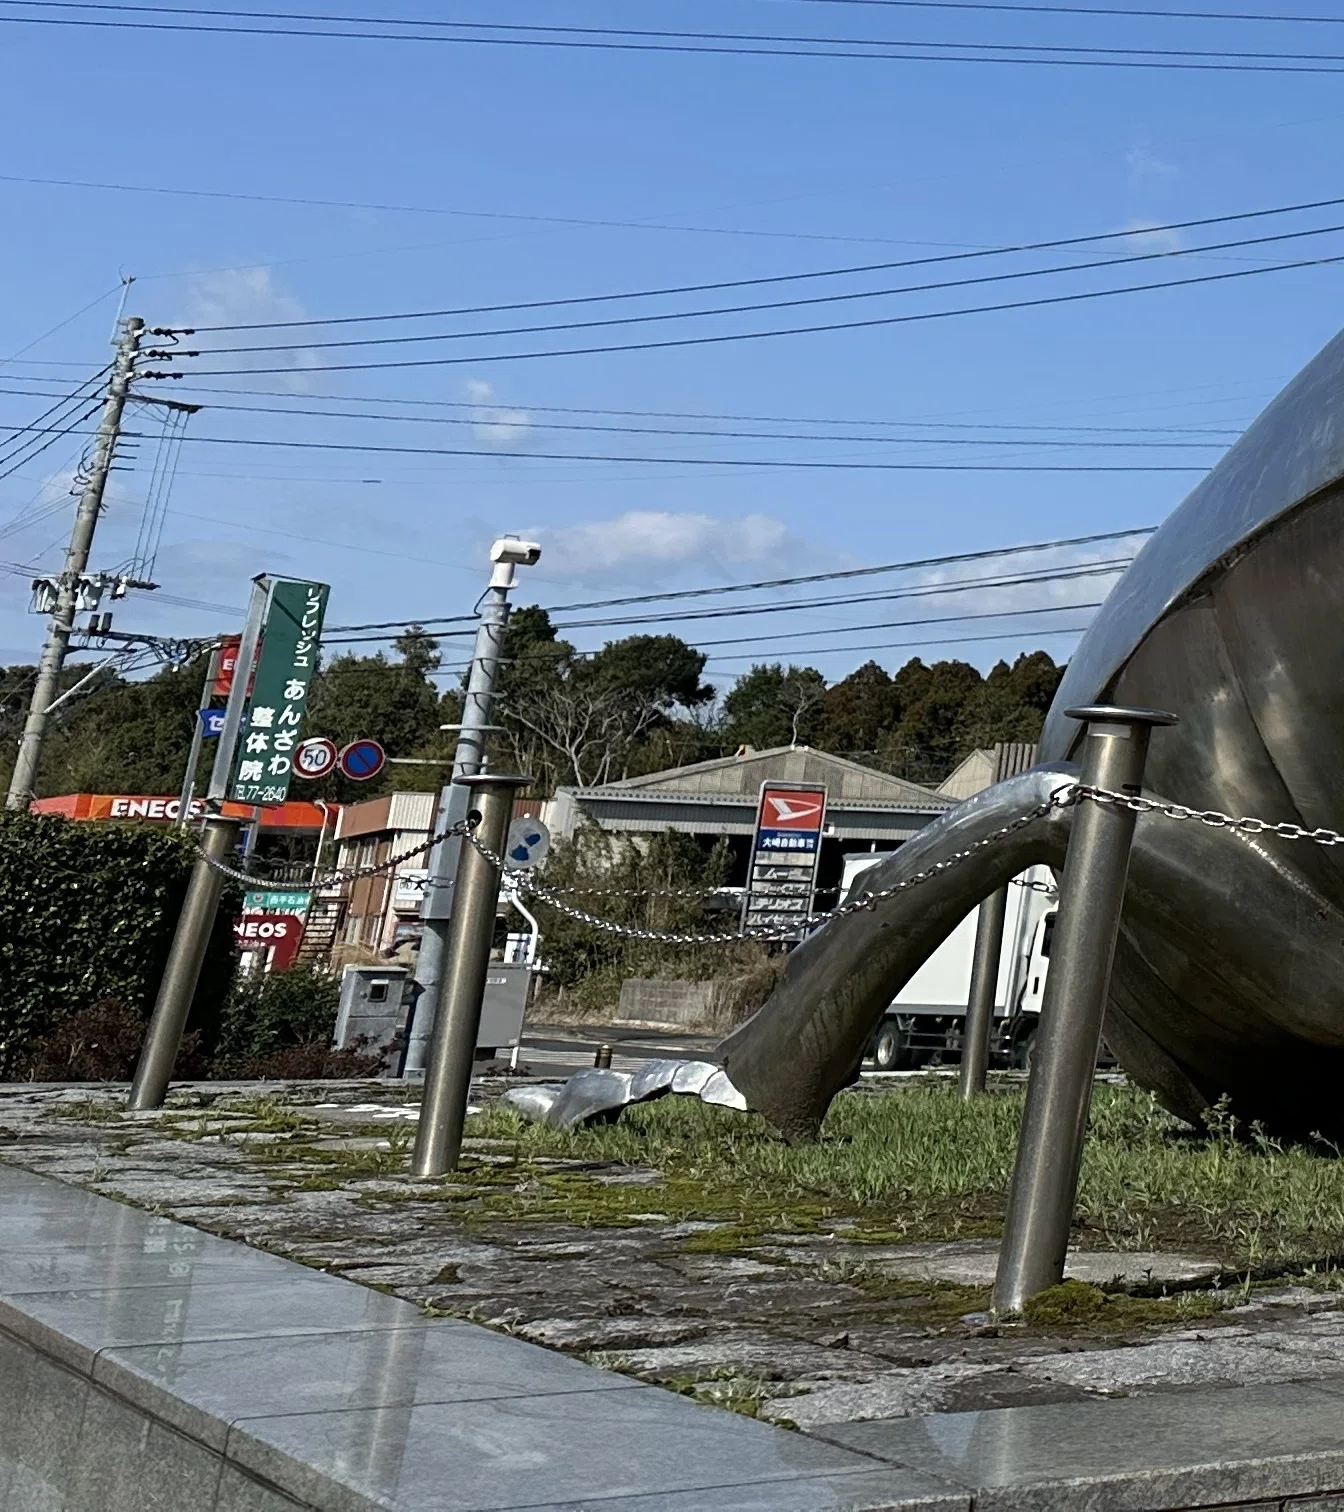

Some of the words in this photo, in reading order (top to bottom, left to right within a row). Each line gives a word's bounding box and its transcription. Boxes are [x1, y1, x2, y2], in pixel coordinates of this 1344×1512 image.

[293, 587, 323, 667] リフレッシュ
[238, 706, 276, 781] 整体院
[268, 679, 305, 776] あんざわ
[303, 749, 327, 767] 50
[110, 798, 201, 819] ENEOS
[233, 922, 287, 938] NEOS
